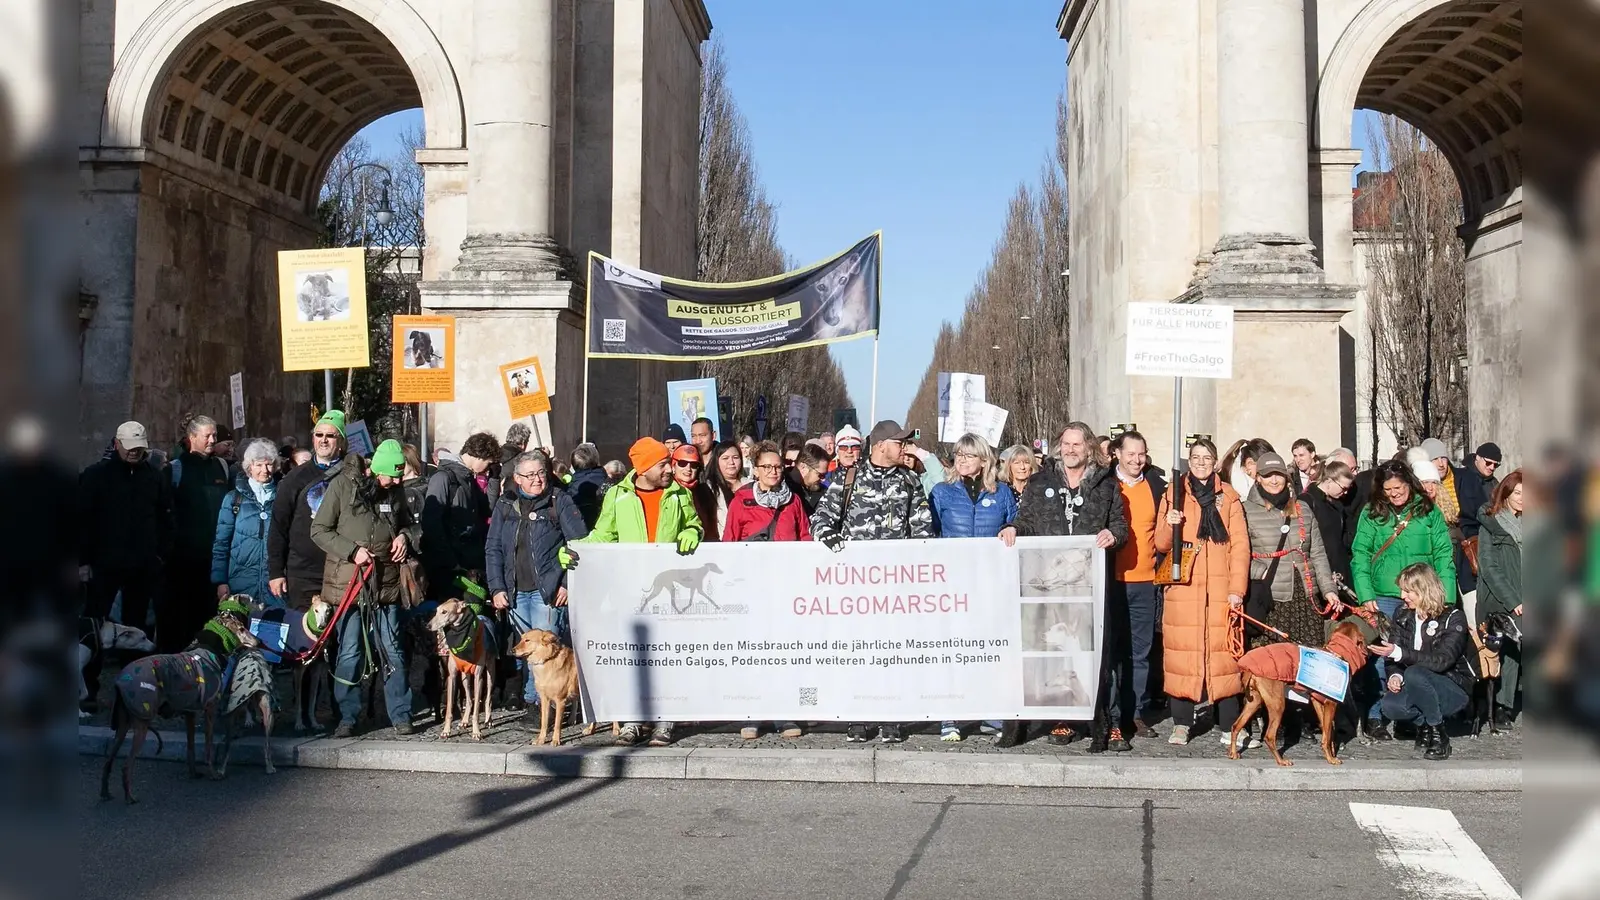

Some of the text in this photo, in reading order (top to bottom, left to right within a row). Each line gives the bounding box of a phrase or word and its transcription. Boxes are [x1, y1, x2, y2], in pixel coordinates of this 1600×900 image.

[676, 302, 767, 315] AUSGENUTZT &
[710, 308, 792, 326] AUSSORTIERT
[1148, 307, 1213, 317] TIERSCHUTZ
[1156, 318, 1181, 328] ALLE
[1186, 320, 1222, 330] HUNDE
[1134, 351, 1224, 367] #FreeTheGalgo
[815, 562, 947, 586] MÜNCHNER
[793, 593, 968, 616] GALGOMARSCH
[587, 636, 1009, 654] Protestmarsch gegen den Missbrauch und die jährliche Massentötung von
[595, 651, 1001, 669] Zehntausenden Galgos, Podencos und weiteren Jagdhunden in Spanien
